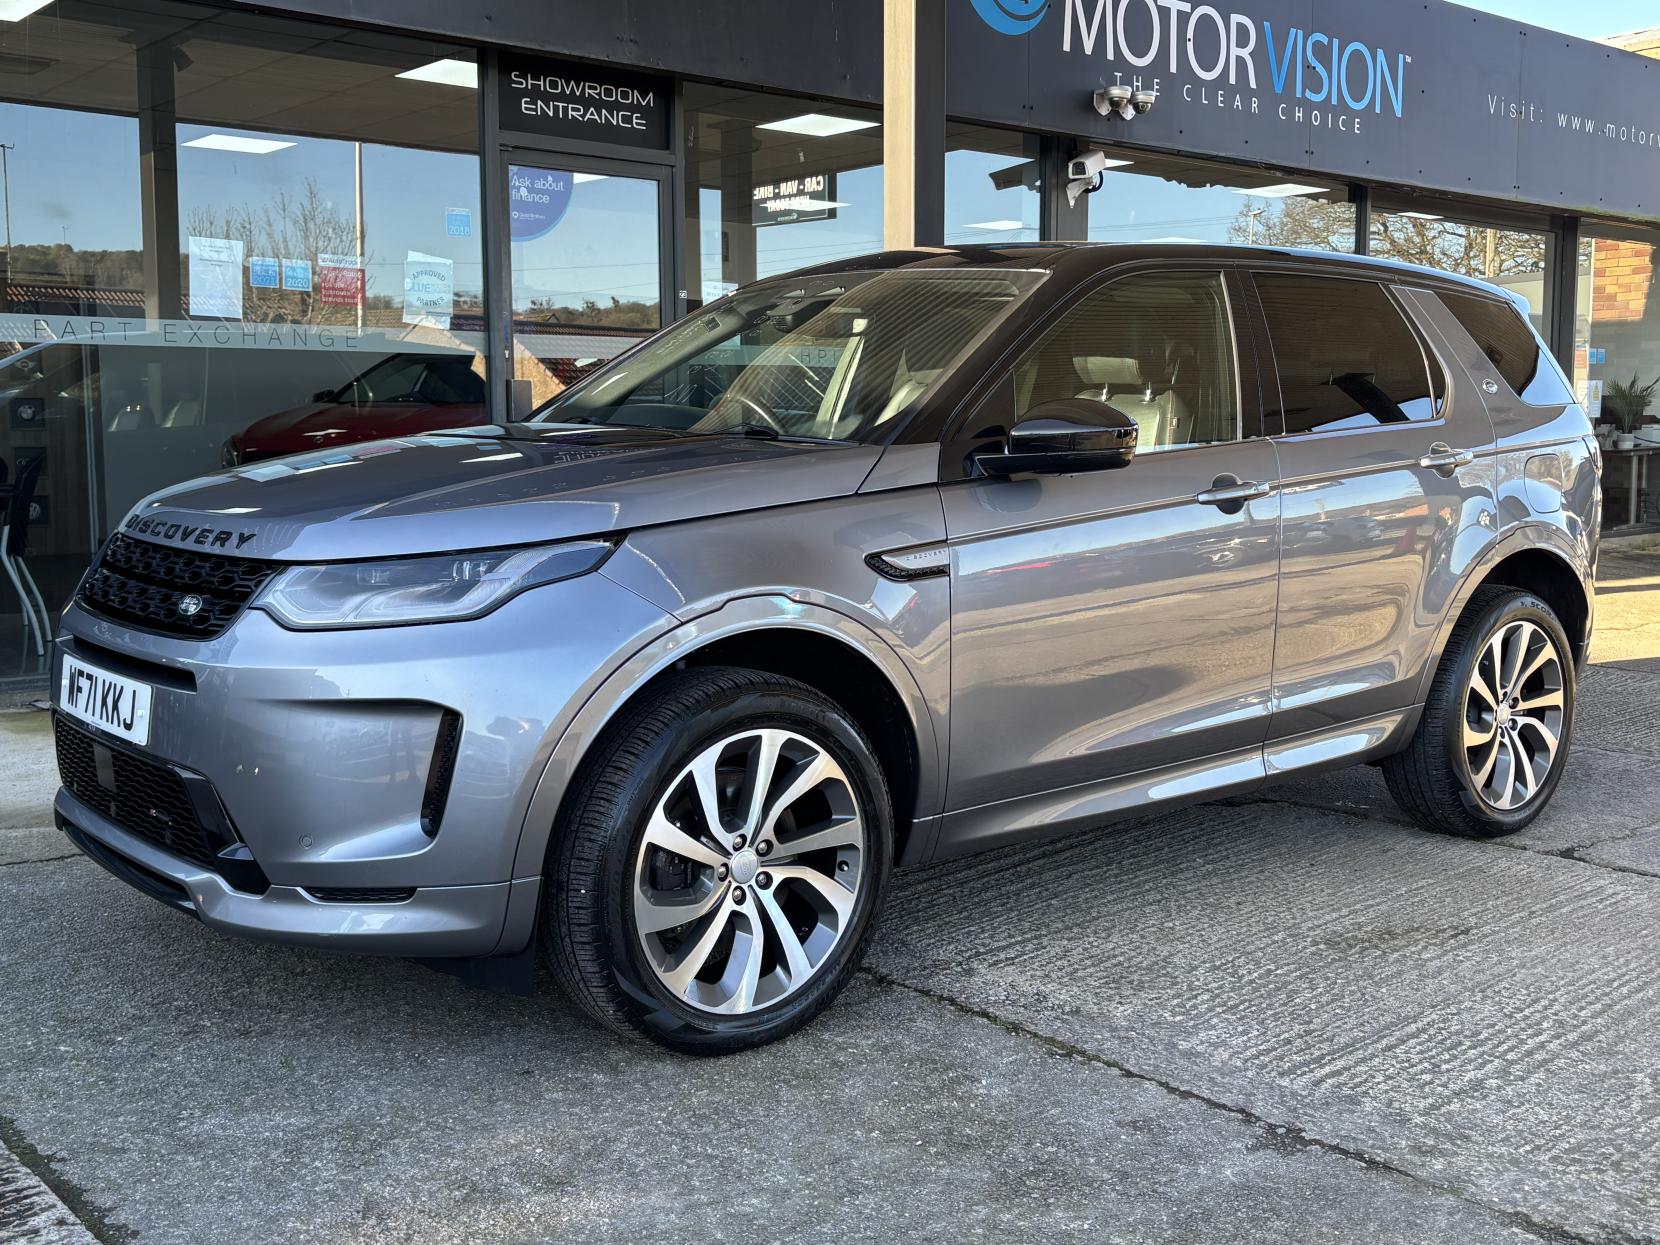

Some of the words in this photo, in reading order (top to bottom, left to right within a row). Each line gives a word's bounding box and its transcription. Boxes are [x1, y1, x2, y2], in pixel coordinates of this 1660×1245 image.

[510, 70, 654, 108] SHOWROOM
[1113, 71, 1160, 96] THE
[1183, 84, 1259, 115] CLEAR
[1278, 104, 1361, 134] CHOICE
[520, 97, 647, 130] ENTRANCE
[1487, 93, 1544, 124] Visit:
[1556, 111, 1660, 148] www.motor
[511, 175, 532, 188] Ask
[534, 177, 564, 192] about
[511, 188, 551, 204] finance
[287, 278, 309, 288] 2020
[411, 269, 446, 282] APPROVED
[33, 319, 132, 341] PART
[163, 323, 358, 348] EXCHANGE
[124, 513, 257, 550] DISCOVERY
